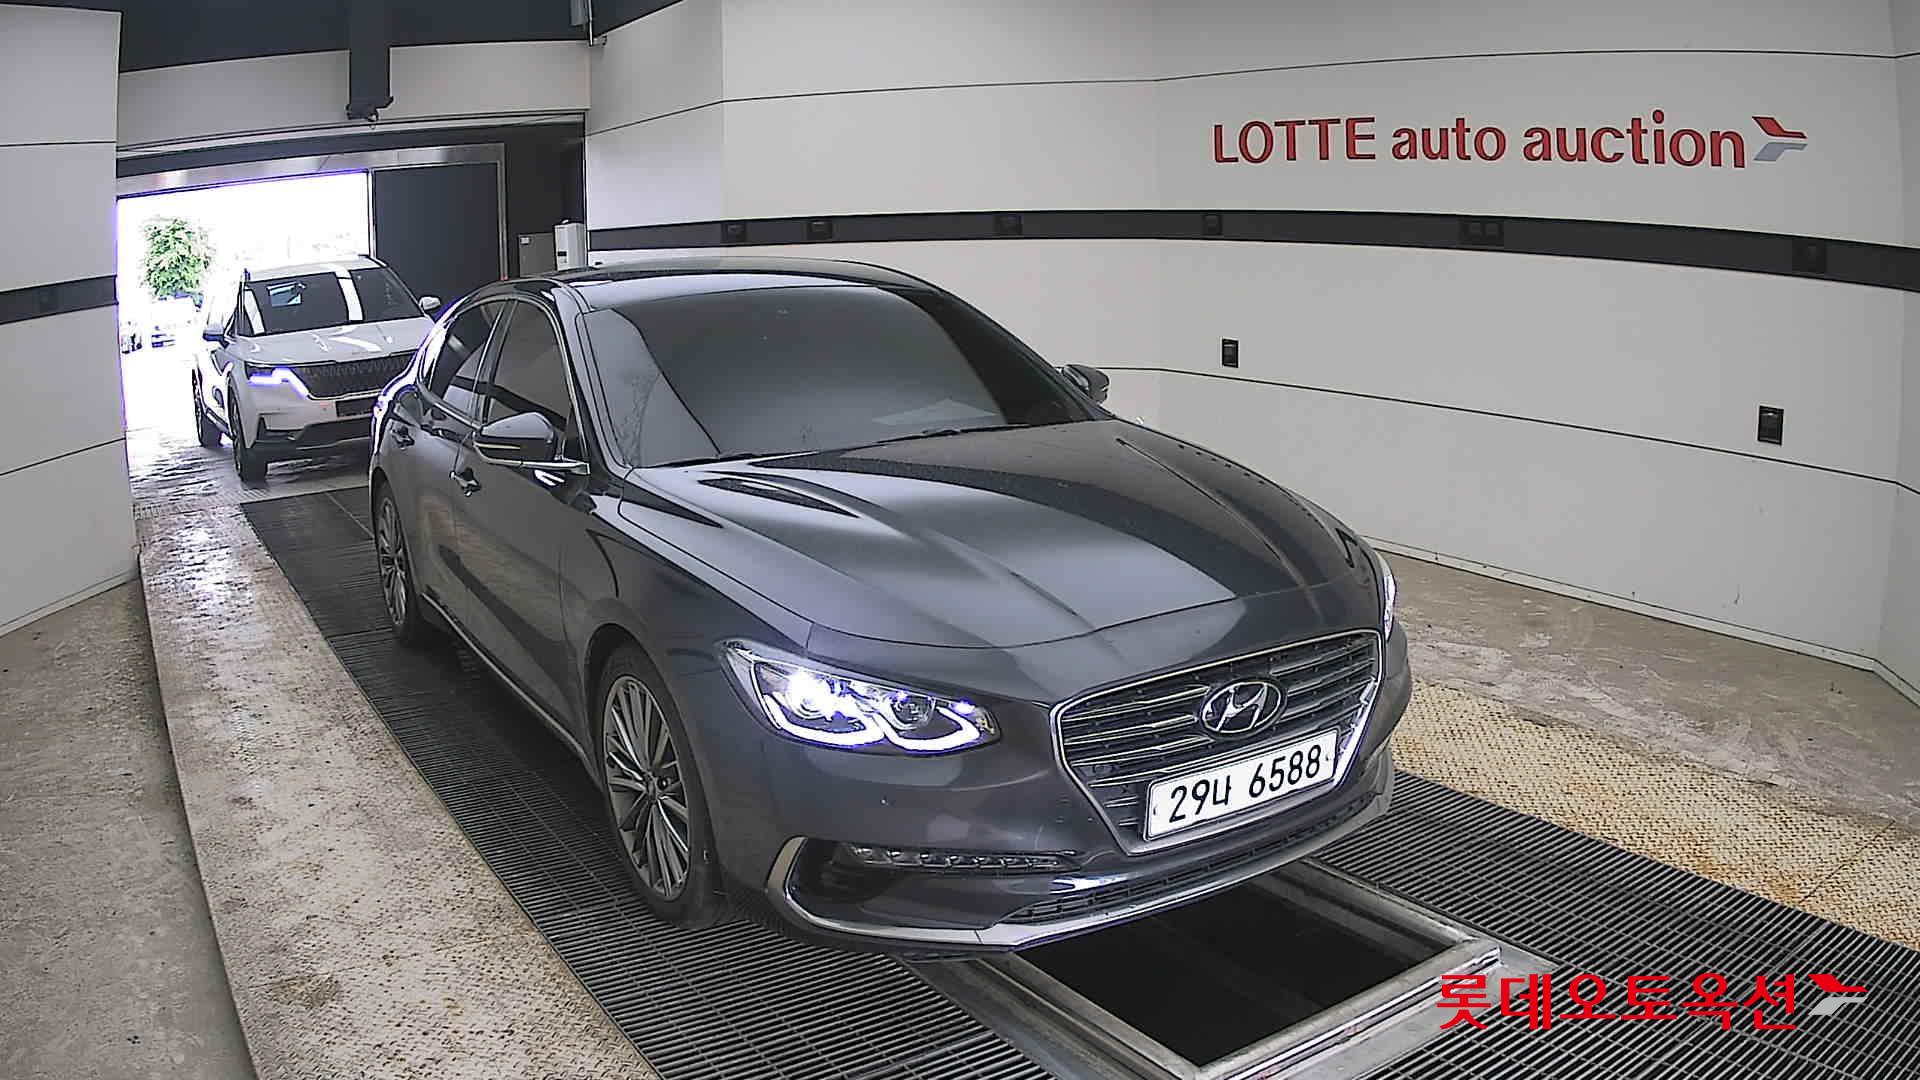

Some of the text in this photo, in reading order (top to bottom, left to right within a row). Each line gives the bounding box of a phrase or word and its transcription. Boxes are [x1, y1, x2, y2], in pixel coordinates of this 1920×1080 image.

[1212, 109, 1746, 168] LOTTE auto auction
[1169, 744, 1322, 823] 29나 6588
